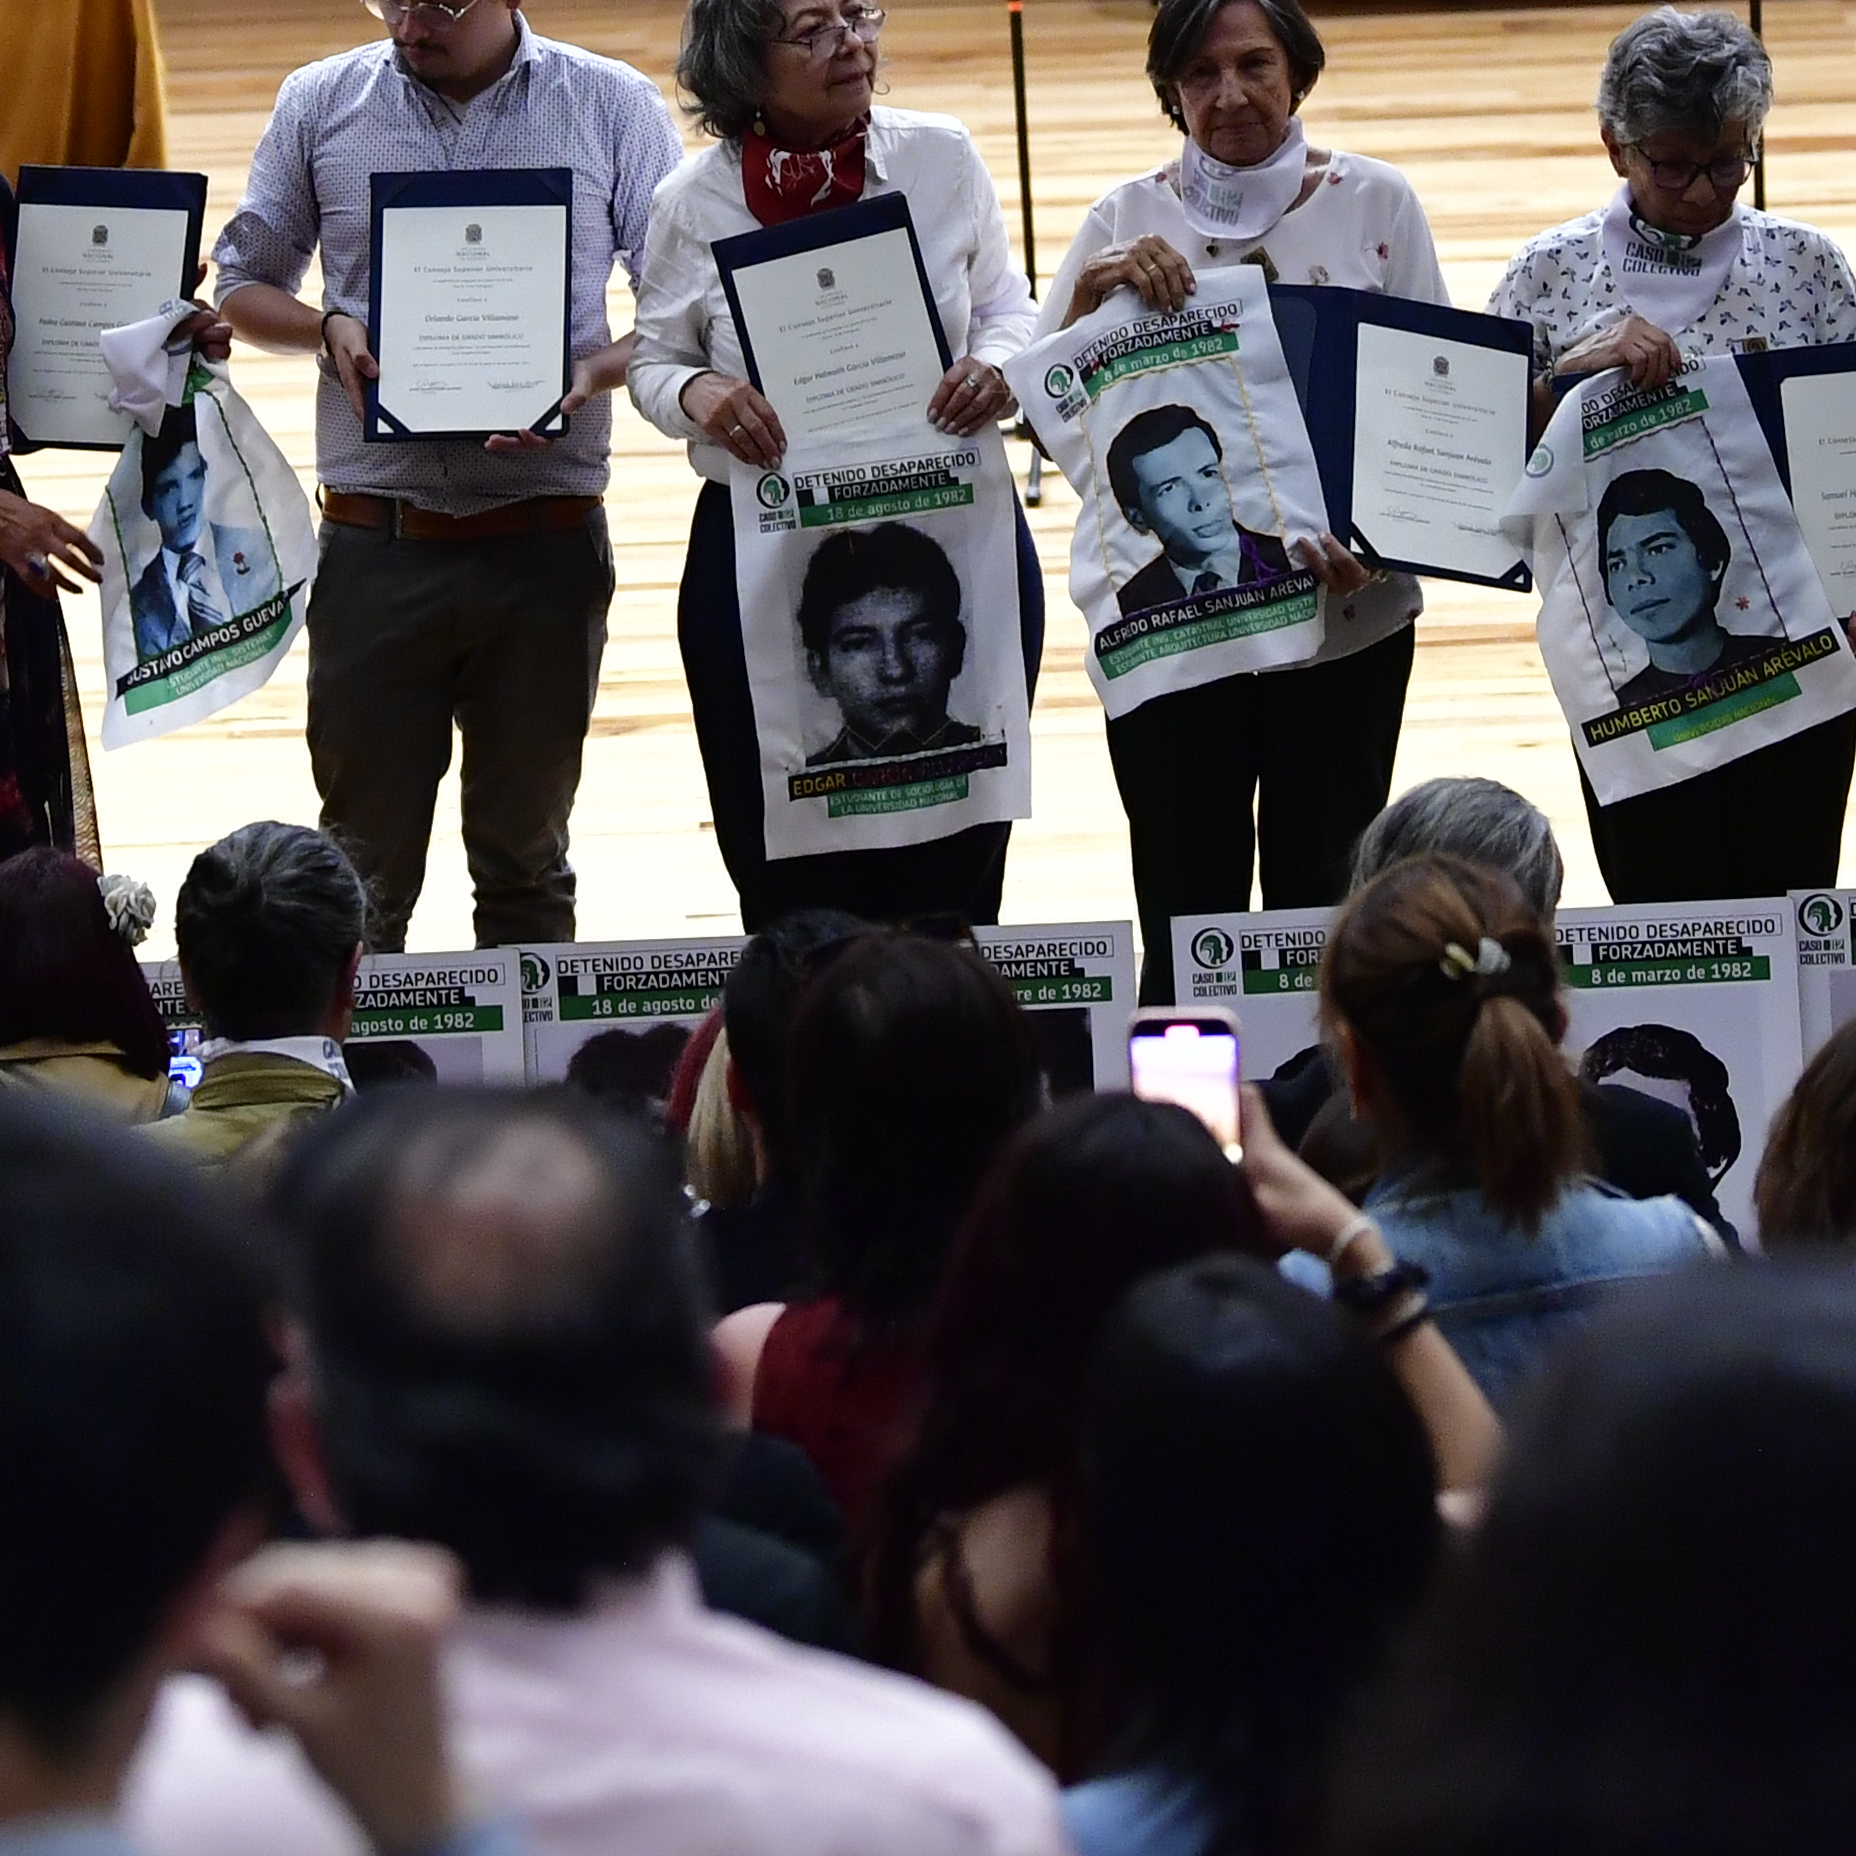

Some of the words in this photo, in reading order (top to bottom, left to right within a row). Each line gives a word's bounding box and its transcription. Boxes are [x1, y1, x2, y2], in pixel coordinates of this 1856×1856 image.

[1074, 326, 1128, 369] DETENIDO
[1132, 303, 1238, 333] DESAPARECIDO
[1102, 322, 1209, 363] FORZADAMENTE
[1104, 370, 1113, 382] 8
[1114, 362, 1127, 376] de
[1131, 352, 1169, 370] marzo
[1191, 338, 1224, 356] 1982
[1583, 385, 1676, 430] ORZADAMENTE
[1590, 434, 1604, 448] de
[1640, 413, 1656, 427] de
[1658, 399, 1692, 420] 1982
[795, 468, 865, 489] DETENIDO
[871, 452, 975, 478] DESAPARECIDO
[834, 473, 946, 499] FORZADAMENTE
[827, 507, 843, 521] 18
[848, 504, 863, 517] de
[868, 499, 910, 516] agosto
[915, 495, 930, 508] de
[935, 490, 966, 505] 1982
[183, 623, 240, 659] CAMPOS
[243, 591, 288, 632] GUEVA
[1100, 618, 1148, 650] ALFREDO
[1150, 604, 1202, 629] RAFAEL
[1205, 589, 1265, 614] SANJUÁN
[1226, 606, 1285, 627] UNIVERSIDAD
[1229, 617, 1288, 637] UNIVERSIDAD
[226, 645, 267, 671] NACIONAL
[168, 656, 209, 688] STUDIANTE
[1590, 698, 1682, 741] HUMBERTO
[1763, 635, 1833, 677] ARÉVALO
[1674, 712, 1732, 743] UNIVERSIDAD
[794, 773, 846, 795] EDGAR
[830, 792, 888, 806] ESTUDIANTE
[841, 805, 854, 814] LA
[856, 800, 917, 813] UNIVERSIDAD
[1241, 931, 1326, 949] DETENIDO
[1556, 925, 1640, 943] DETENIDO
[1646, 918, 1776, 940] DESAPARECIDO
[981, 941, 1107, 960] DESAPARECIDO
[1599, 939, 1738, 961] FORZADAMENTE
[1799, 940, 1822, 952] CASO
[557, 956, 644, 975] DETENIDO
[651, 950, 744, 969] DESAPARE
[995, 961, 1070, 978] AMENTE
[1799, 953, 1845, 965] COLECTIVO
[369, 968, 499, 988] DESAPARECIDO
[604, 970, 732, 992] FORZADAMENT
[1193, 972, 1214, 984] CASO
[1279, 974, 1289, 989] 8
[1295, 973, 1313, 987] de
[1591, 968, 1601, 985] 8
[1607, 967, 1626, 983] de
[1632, 967, 1681, 982] marzo
[1686, 964, 1705, 980] de
[1711, 962, 1752, 979] 1982
[356, 989, 460, 1009] ZADAMENTE
[1038, 986, 1056, 999] de
[1062, 983, 1101, 999] 1982
[1193, 985, 1237, 998] COLECTIVO
[592, 999, 613, 1015] 18
[618, 997, 637, 1014] de
[643, 996, 695, 1016] agosto
[701, 995, 719, 1010] de
[351, 1017, 404, 1035] agosto
[409, 1015, 428, 1031] de
[433, 1012, 474, 1030] 1982
[524, 1011, 553, 1023] ECTIVO
